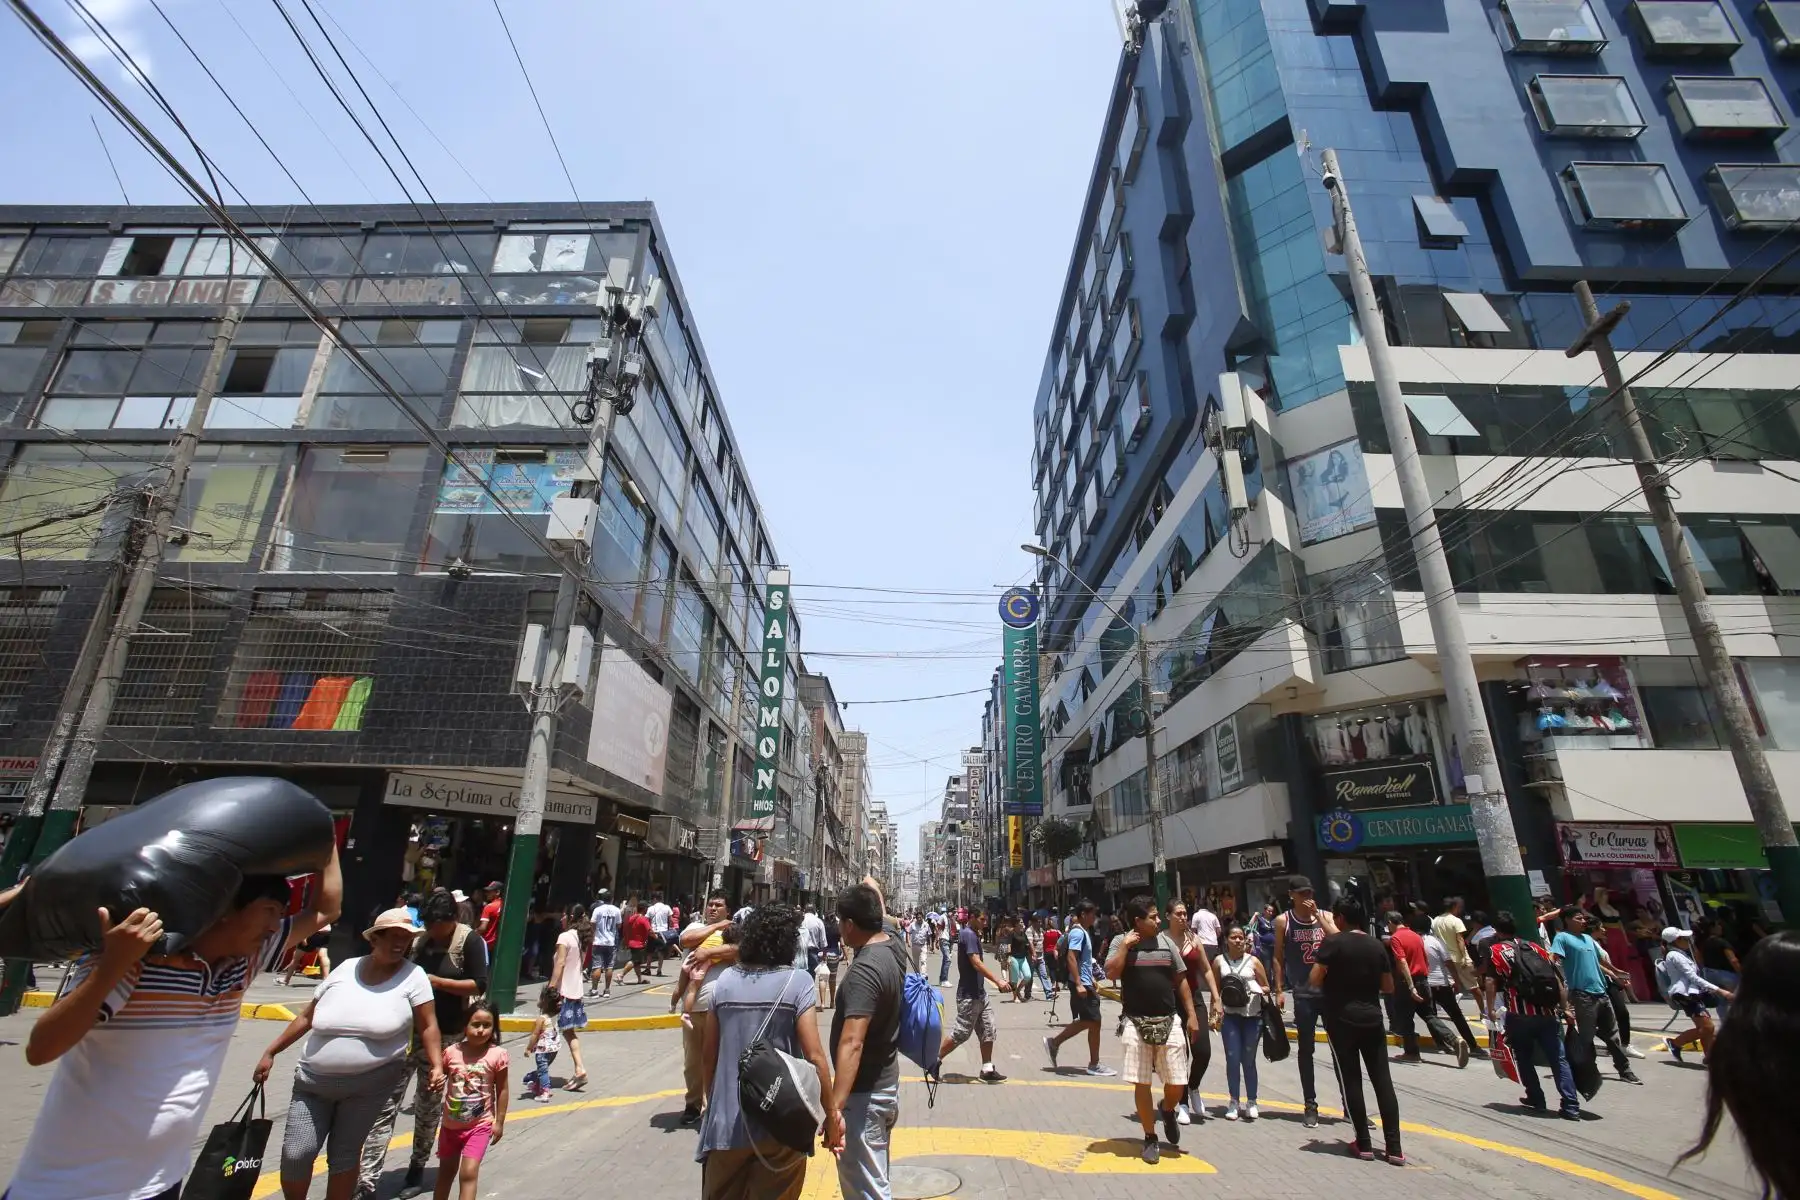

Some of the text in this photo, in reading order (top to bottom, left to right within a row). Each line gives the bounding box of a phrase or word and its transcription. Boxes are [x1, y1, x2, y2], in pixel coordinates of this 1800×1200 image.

[130, 280, 249, 305] GRANDE
[316, 276, 463, 304] GAMARRA
[756, 590, 784, 790] SALOMON
[1013, 637, 1032, 716] GAMARRA
[0, 759, 38, 769] TINA
[1014, 724, 1035, 793] CENTRO
[391, 778, 412, 796] La
[420, 781, 492, 807] Séptima
[543, 802, 592, 816] amarra
[1368, 814, 1475, 838] CENTRO GAMAR
[1589, 831, 1649, 848] En Curvas
[1606, 852, 1655, 860] COLOMBIANAS
